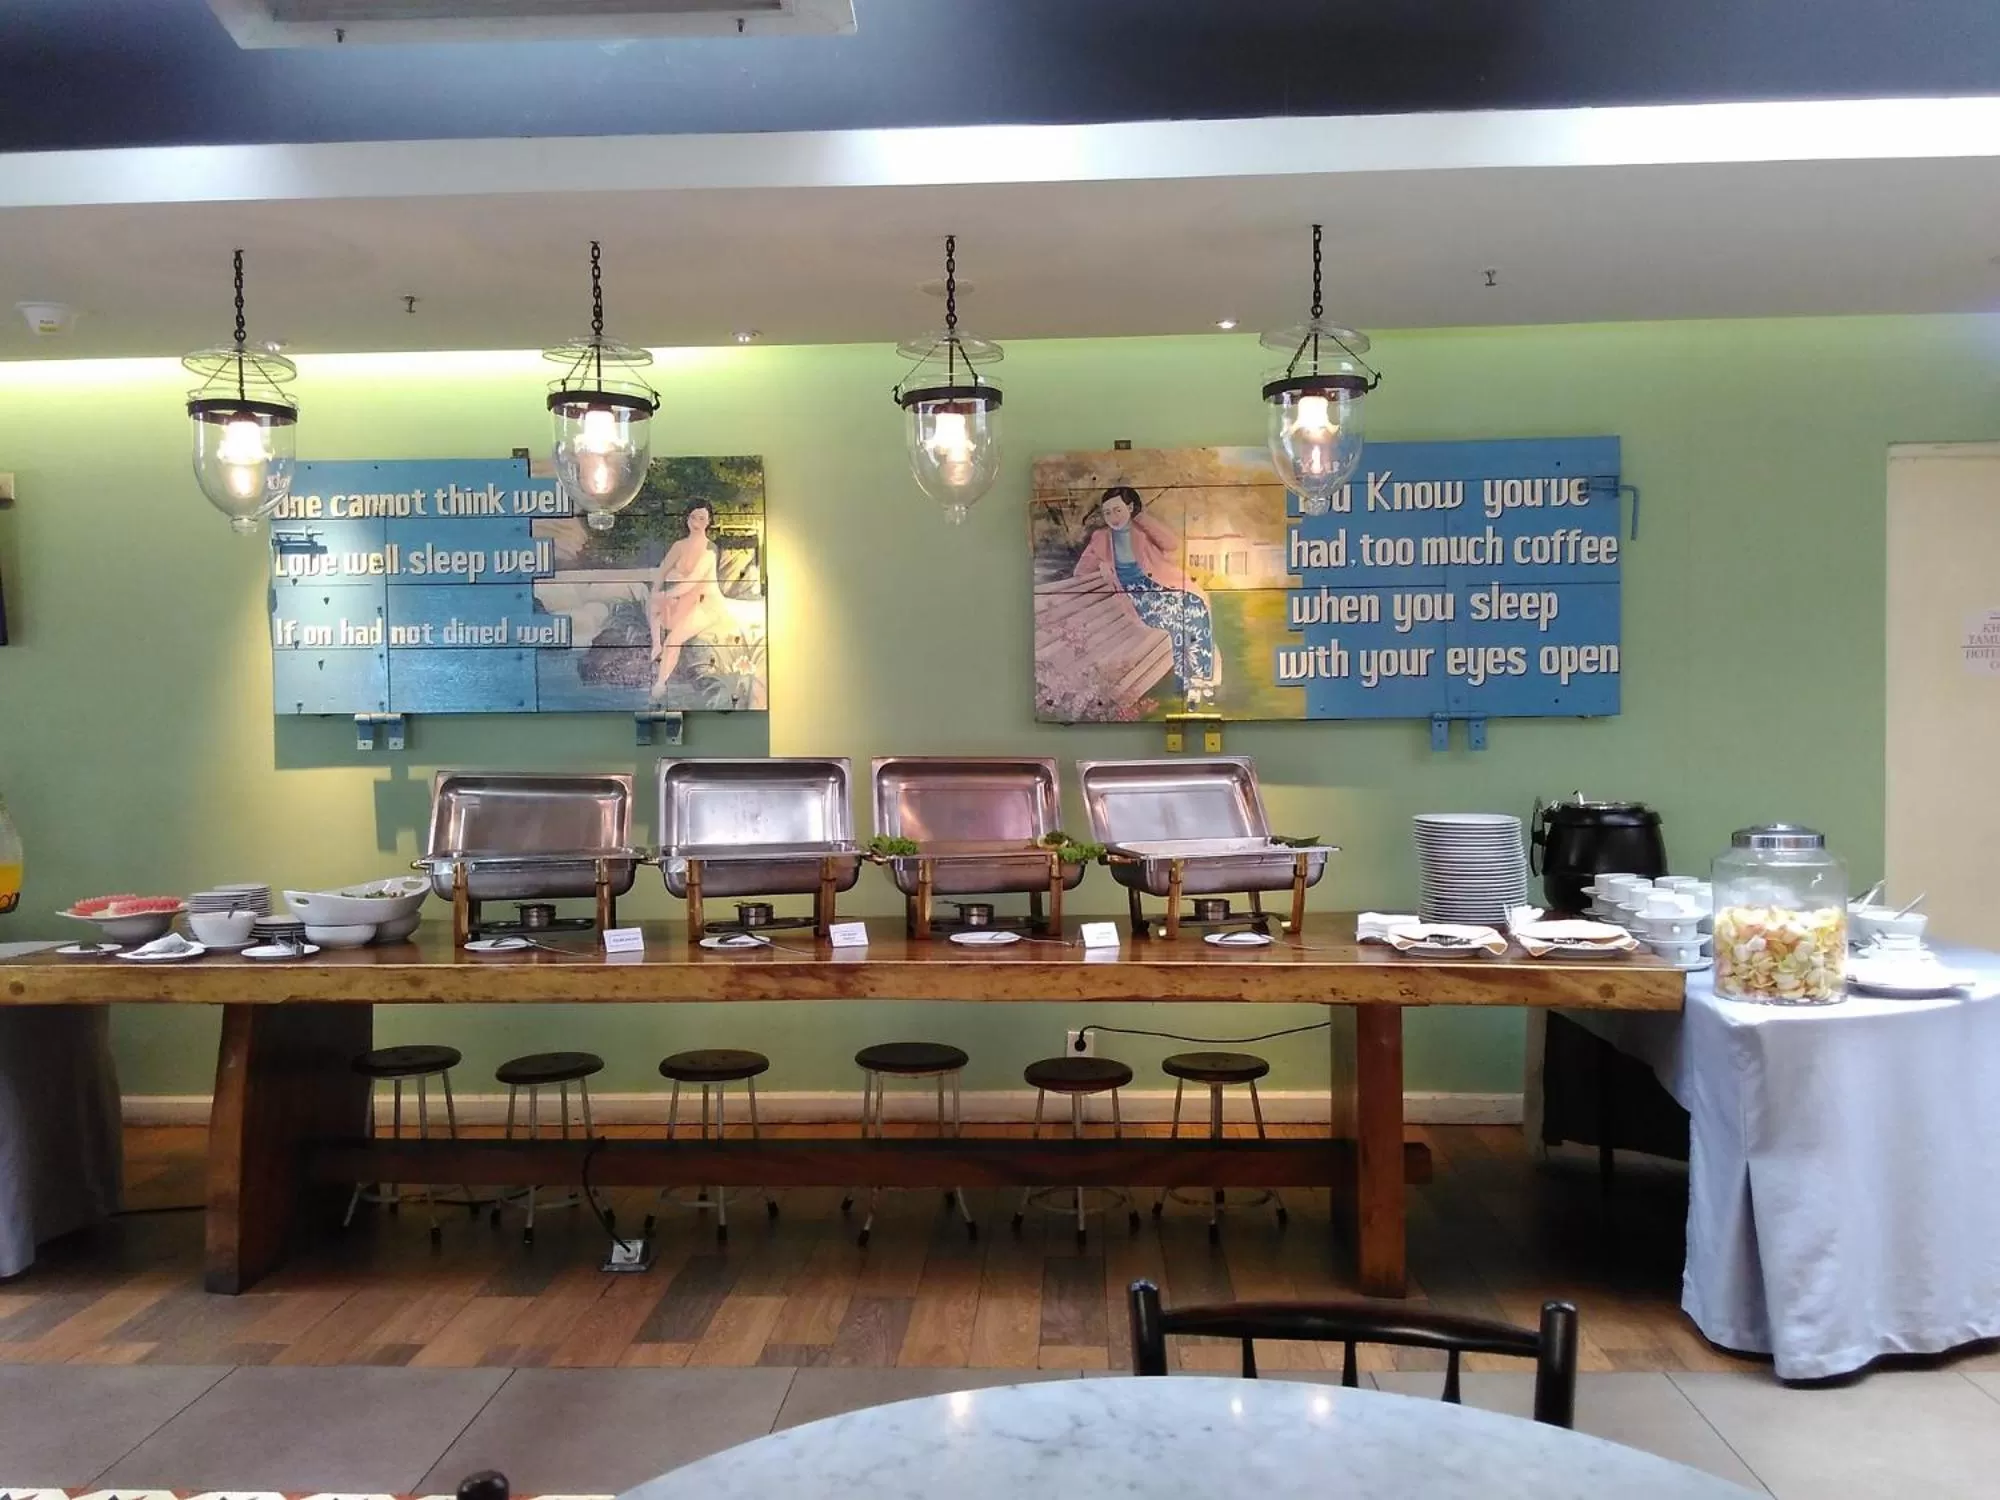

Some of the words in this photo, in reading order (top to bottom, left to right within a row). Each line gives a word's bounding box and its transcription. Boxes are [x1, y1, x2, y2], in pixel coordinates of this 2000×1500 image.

[330, 488, 428, 518] cannot
[434, 483, 506, 516] think
[513, 481, 572, 515] well
[1367, 471, 1465, 511] Know
[1484, 477, 1591, 519] you've
[275, 551, 339, 578] Love
[409, 543, 485, 584] sleep
[494, 541, 553, 574] well
[1359, 533, 1414, 566] too
[1422, 526, 1503, 565] much
[1514, 529, 1618, 565] coffee
[1292, 585, 1380, 624] when
[1393, 594, 1454, 633] you
[1470, 581, 1558, 632] sleep
[276, 618, 297, 646] If
[303, 626, 333, 645] on
[340, 618, 384, 645] had
[391, 622, 434, 646] not
[443, 617, 508, 645] dined
[516, 616, 571, 645] well
[1279, 639, 1349, 680] with
[1359, 647, 1435, 687] your
[1447, 646, 1527, 686] eyes
[1539, 644, 1619, 685] open
